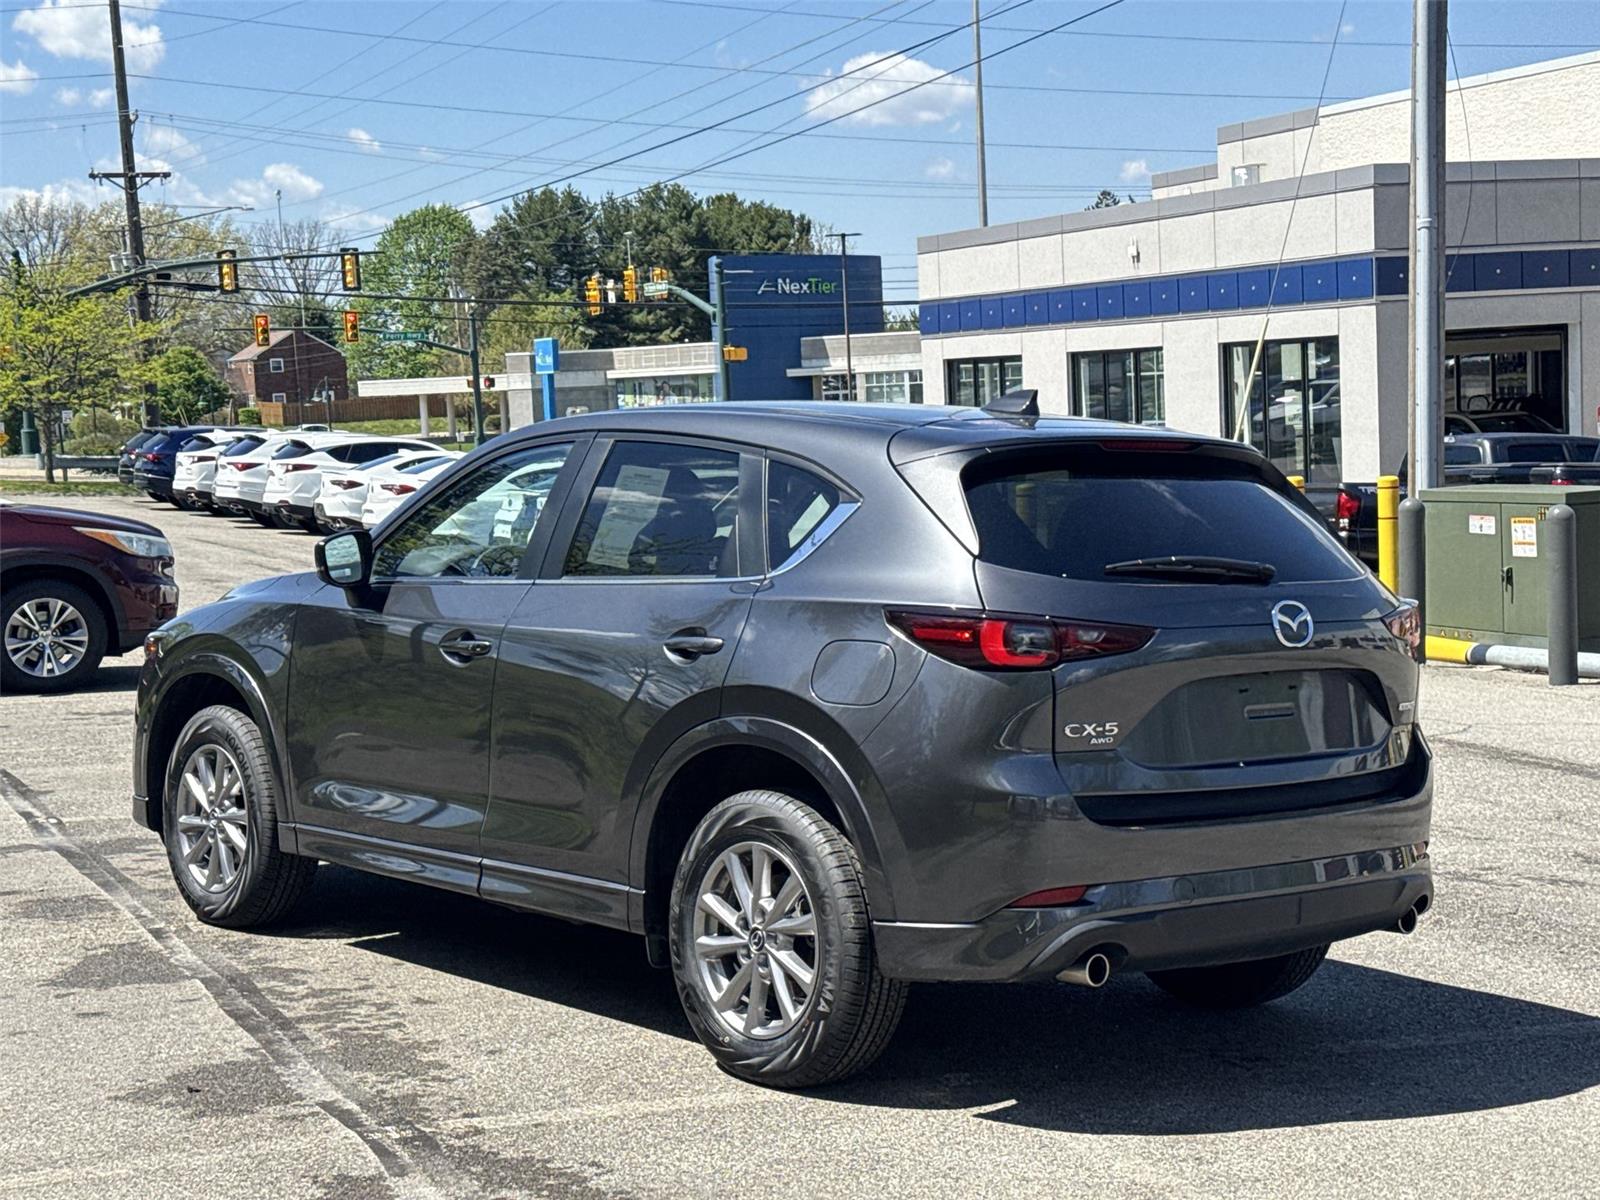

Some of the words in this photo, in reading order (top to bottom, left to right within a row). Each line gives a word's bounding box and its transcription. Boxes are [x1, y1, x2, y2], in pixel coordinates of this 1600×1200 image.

[777, 277, 837, 294] NexTier
[1064, 721, 1119, 738] CX-5
[1090, 737, 1114, 745] AWD
[224, 730, 256, 810] YOKOHAMA
